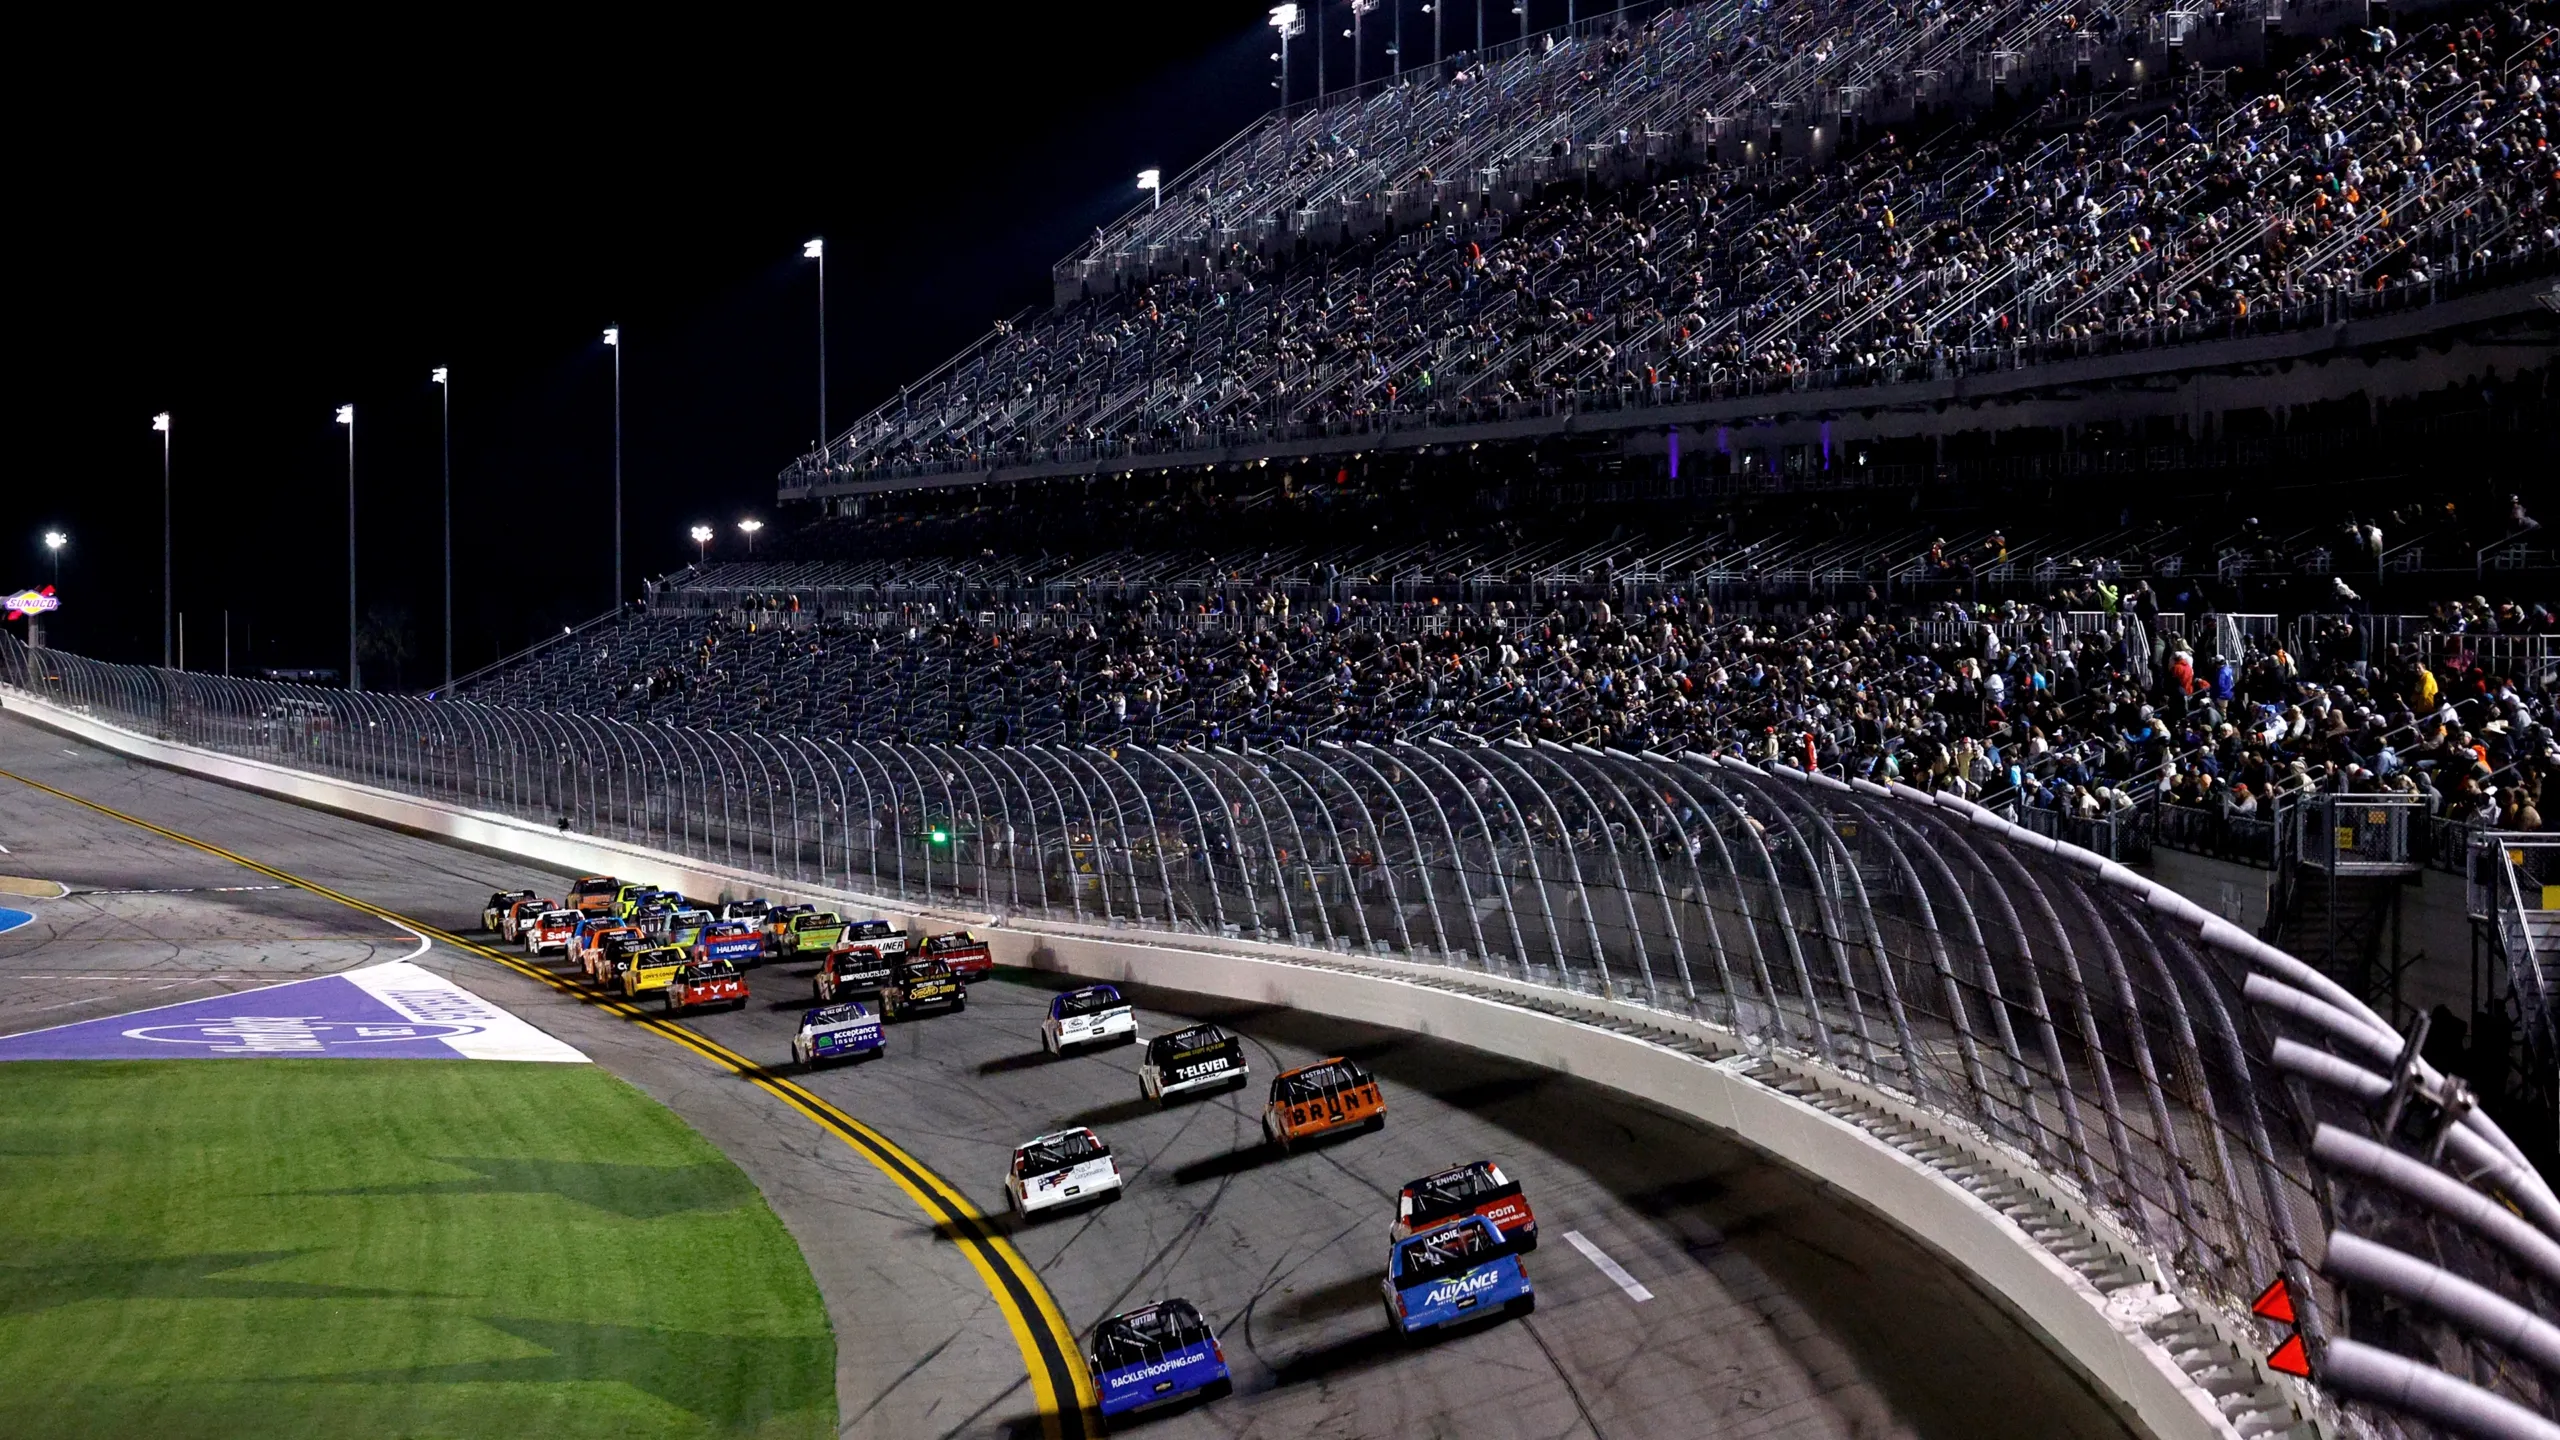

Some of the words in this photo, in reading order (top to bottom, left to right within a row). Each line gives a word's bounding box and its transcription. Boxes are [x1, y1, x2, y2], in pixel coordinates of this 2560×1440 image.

[8, 599, 55, 608] SUNOCO
[716, 944, 748, 954] HALMAR
[834, 1025, 877, 1039] acceptance
[835, 1032, 878, 1045] insurance
[1175, 1030, 1196, 1040] HALEY
[1293, 1087, 1374, 1126] BRUNT
[1042, 1136, 1065, 1147] WRIGHT
[1426, 1229, 1459, 1246] LAJOIE
[1130, 1312, 1156, 1328] SUTTON
[1111, 1352, 1205, 1389] RACKLEYROOFING.com
